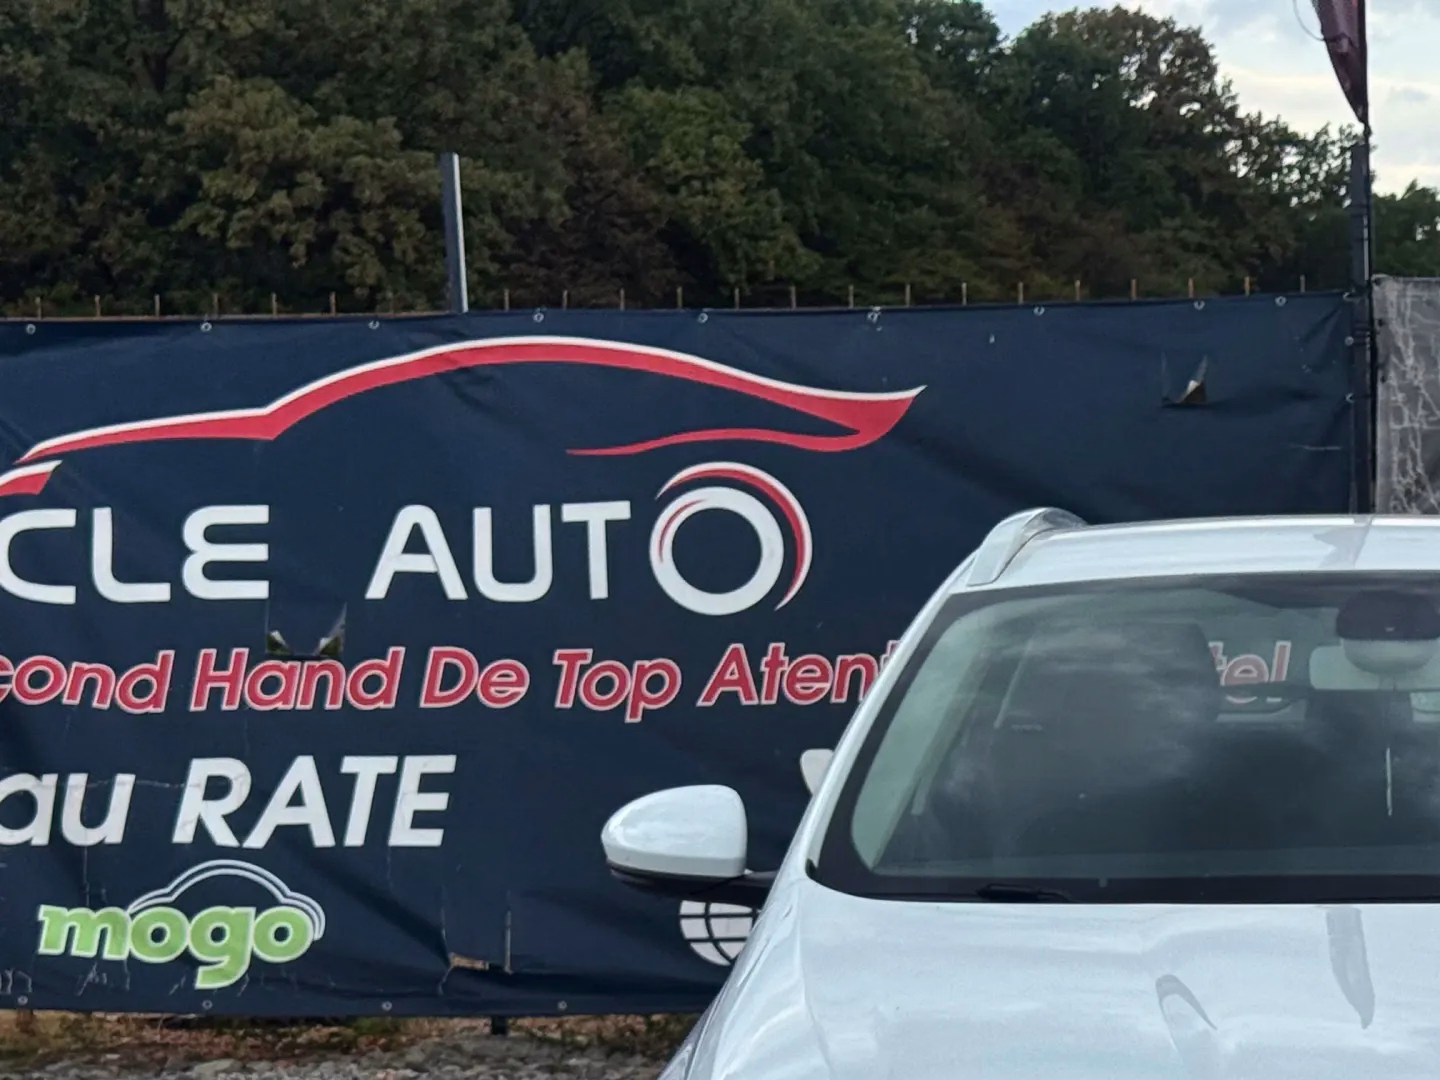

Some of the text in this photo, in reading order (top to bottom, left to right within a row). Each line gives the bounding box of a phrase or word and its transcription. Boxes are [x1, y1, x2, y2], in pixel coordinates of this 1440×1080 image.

[0, 486, 785, 616] CLE AUTO
[189, 646, 406, 712] Hand
[419, 646, 529, 709] De
[553, 648, 682, 723] Top
[696, 639, 903, 707] Aten
[172, 754, 457, 849] RATE
[37, 902, 314, 989] mogo
